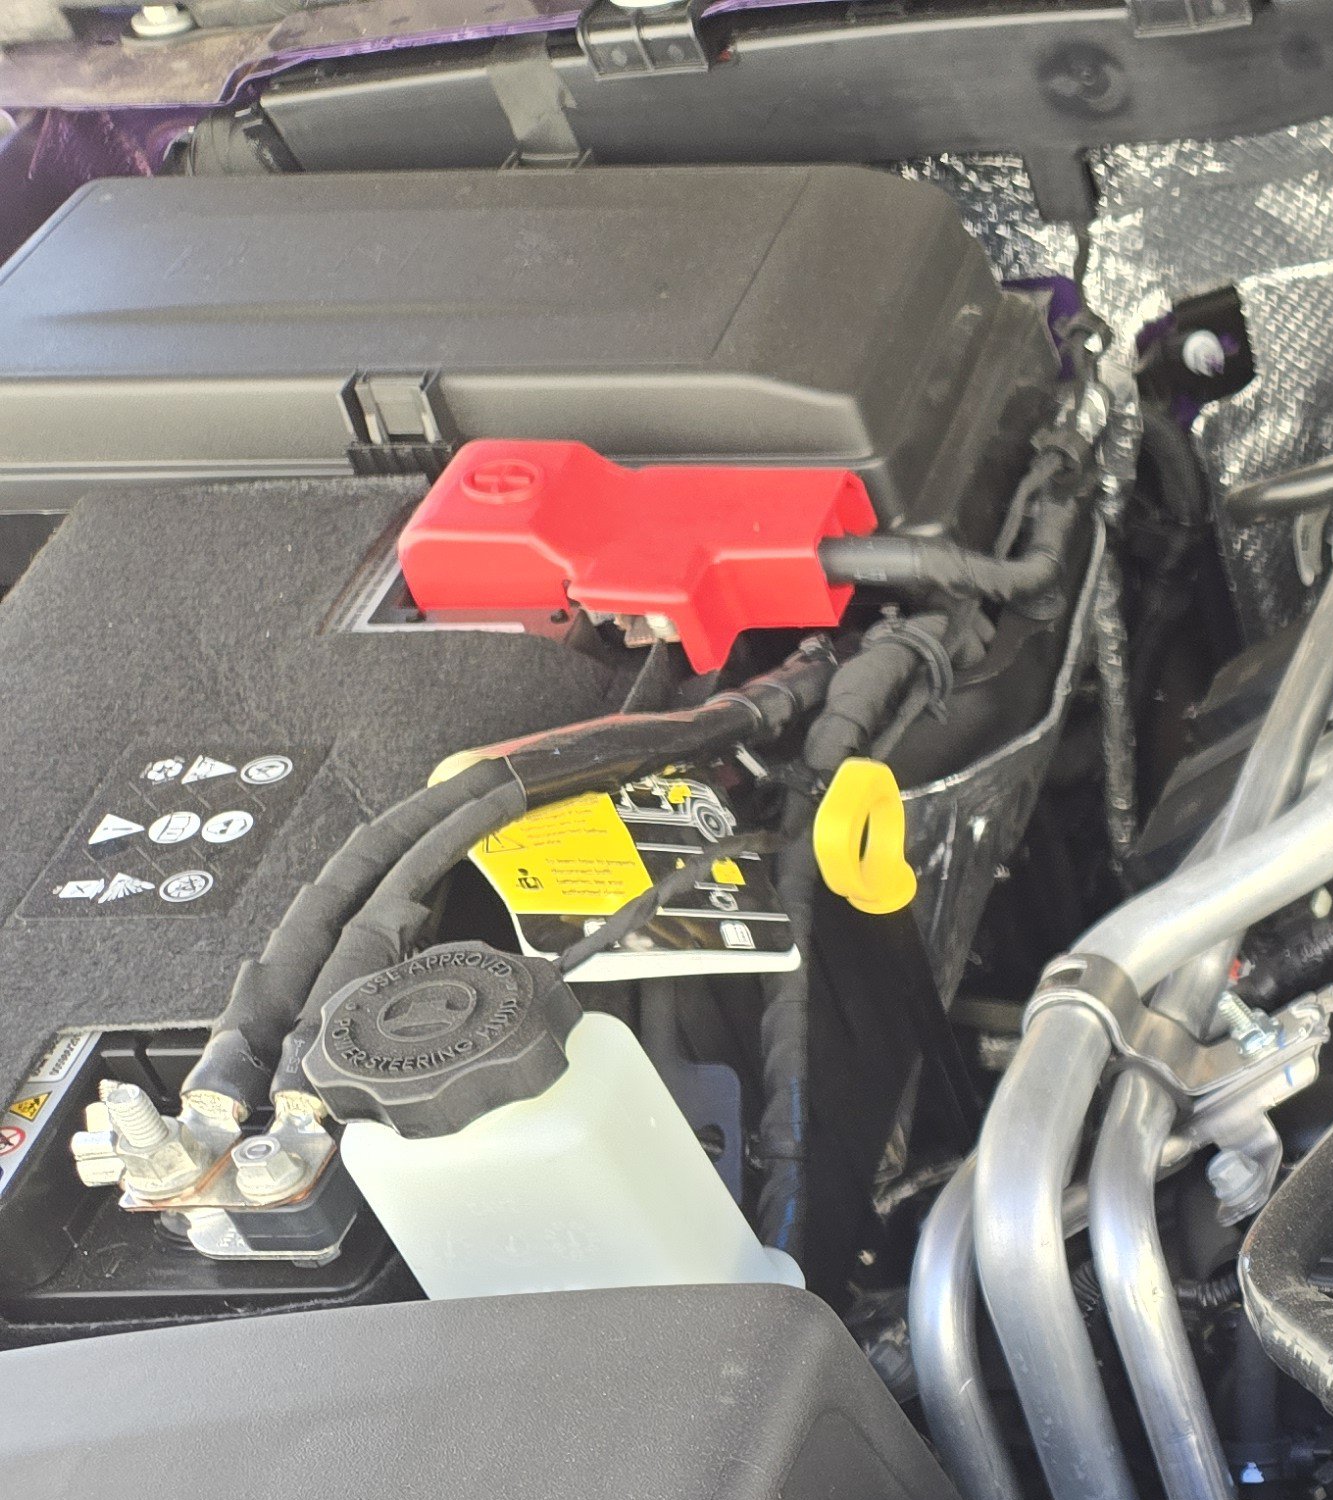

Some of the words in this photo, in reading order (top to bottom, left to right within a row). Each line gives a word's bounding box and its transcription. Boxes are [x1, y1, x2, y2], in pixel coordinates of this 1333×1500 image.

[360, 967, 400, 995] USE
[408, 951, 512, 978] APPROVED
[332, 1018, 366, 1065] POWER
[367, 1039, 473, 1071] STEERING
